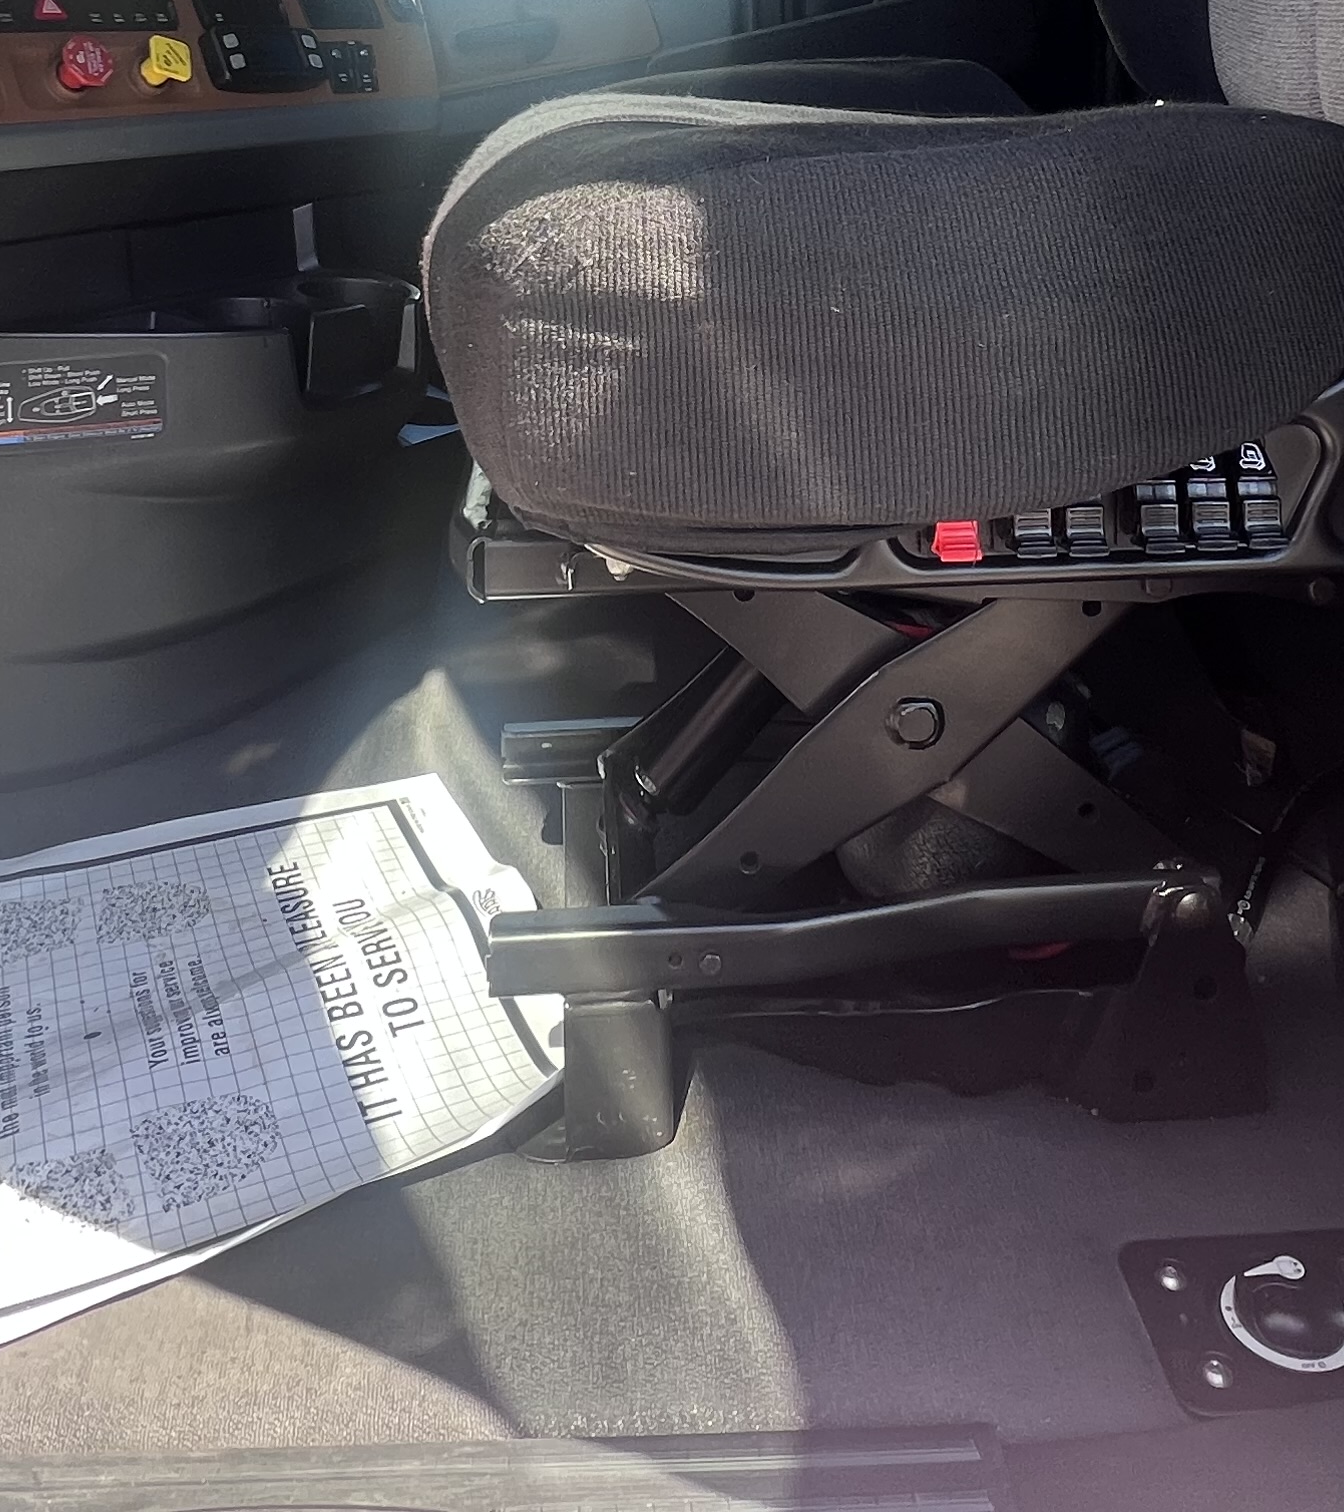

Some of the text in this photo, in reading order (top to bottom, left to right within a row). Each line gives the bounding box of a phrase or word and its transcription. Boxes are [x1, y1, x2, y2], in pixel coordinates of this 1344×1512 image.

[130, 972, 148, 988] for
[157, 960, 181, 998] service
[309, 954, 364, 1023] BEEN
[24, 1025, 44, 1039] to
[381, 997, 425, 1038] TO
[148, 1036, 169, 1069] Your
[211, 1031, 230, 1056] are
[335, 1030, 389, 1092] HAS
[357, 1097, 403, 1125] IT
